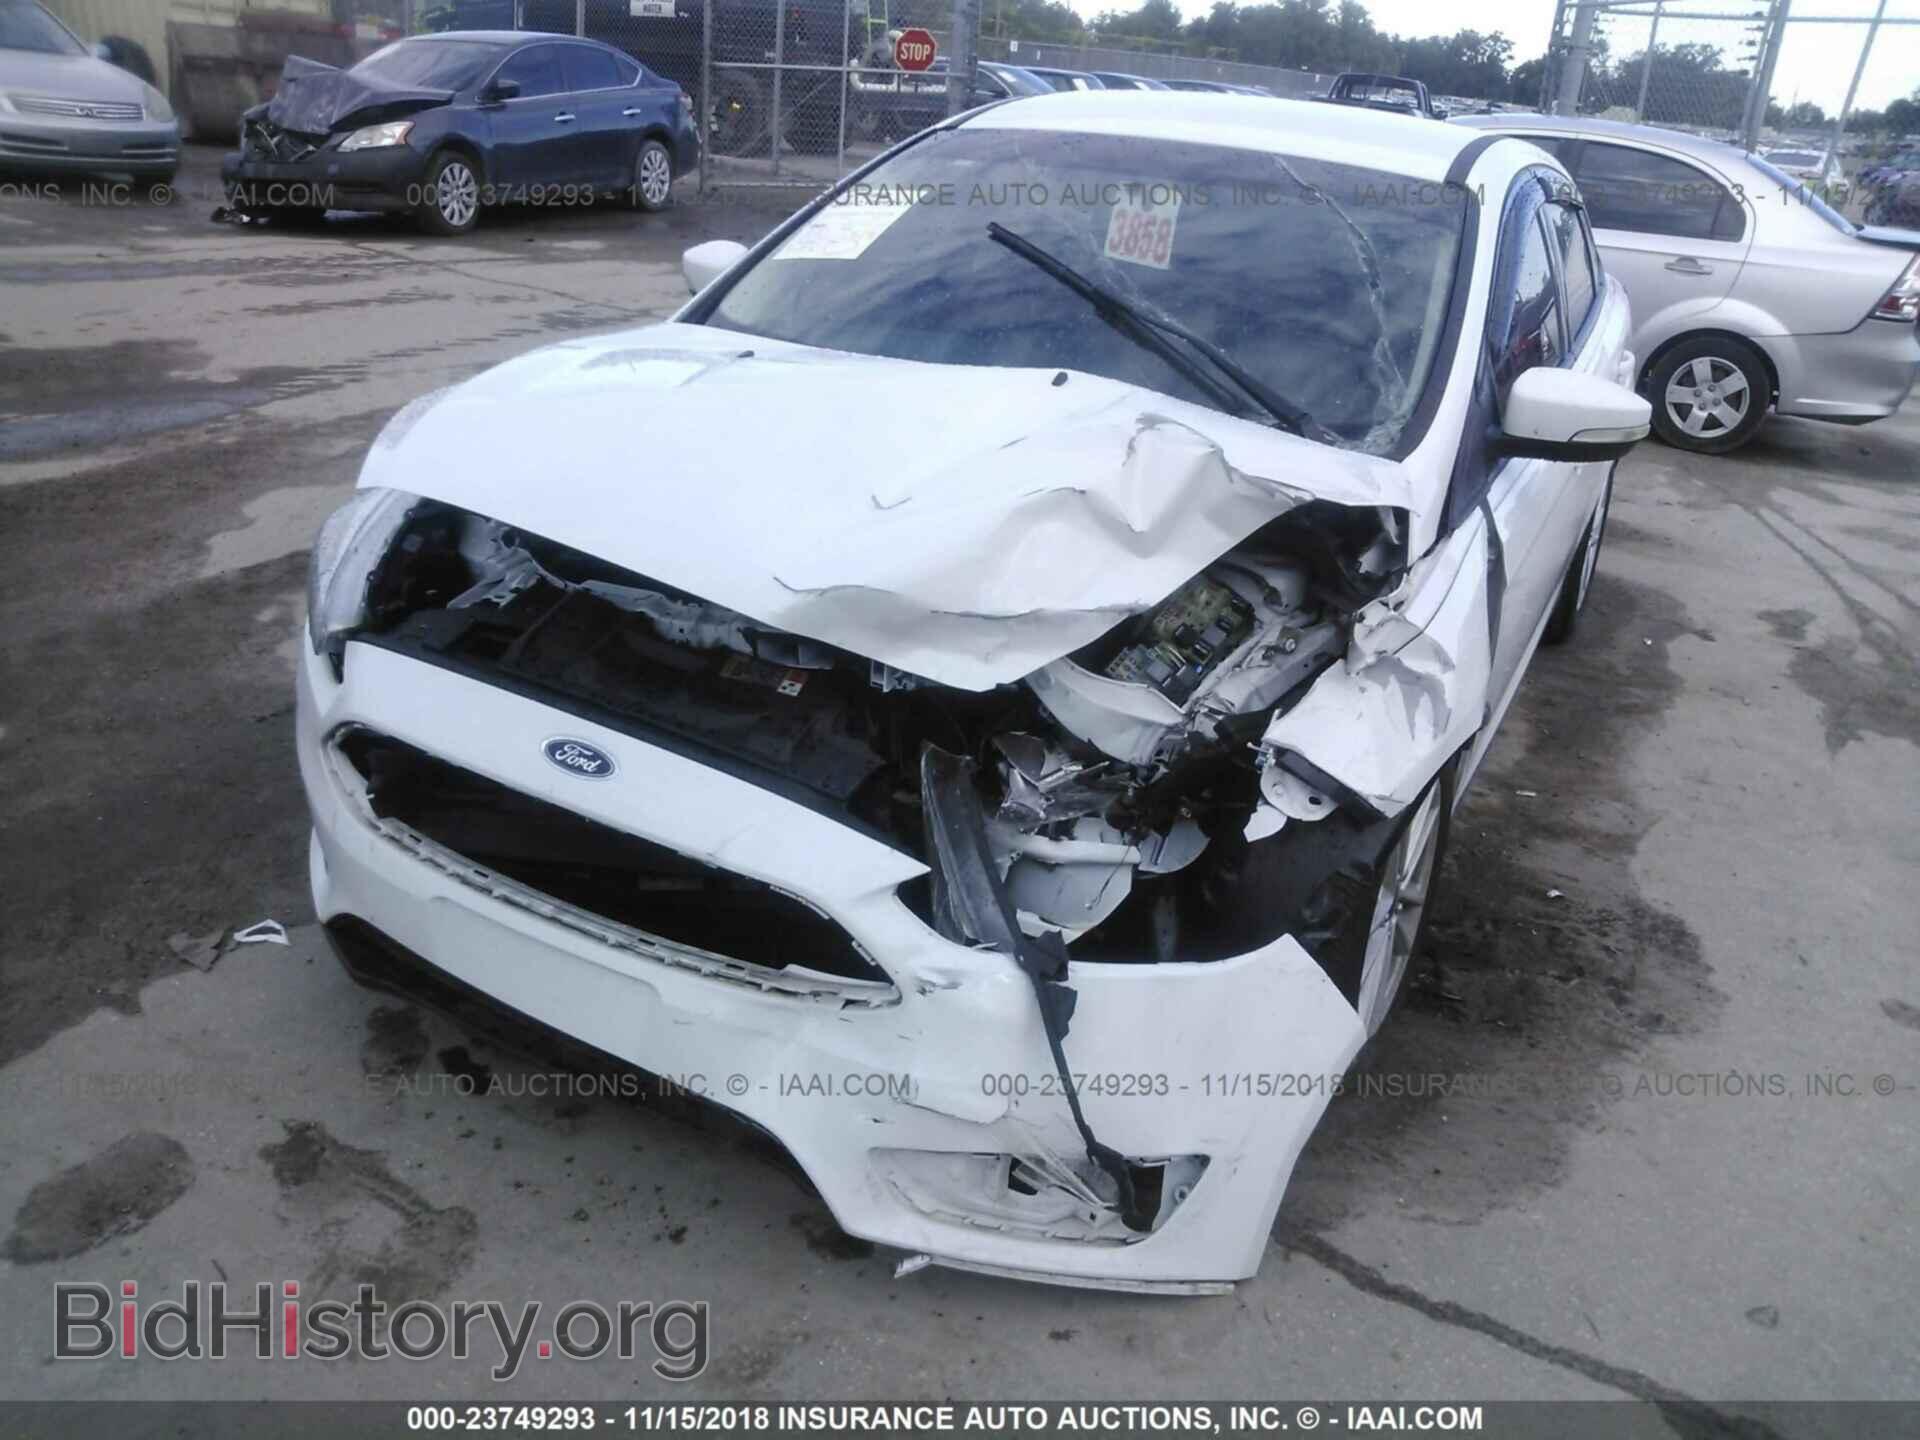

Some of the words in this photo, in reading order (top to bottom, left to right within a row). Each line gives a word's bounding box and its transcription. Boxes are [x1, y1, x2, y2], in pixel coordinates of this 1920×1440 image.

[900, 42, 931, 61] STOP
[1107, 208, 1173, 264] 3858
[555, 743, 602, 772] Ford
